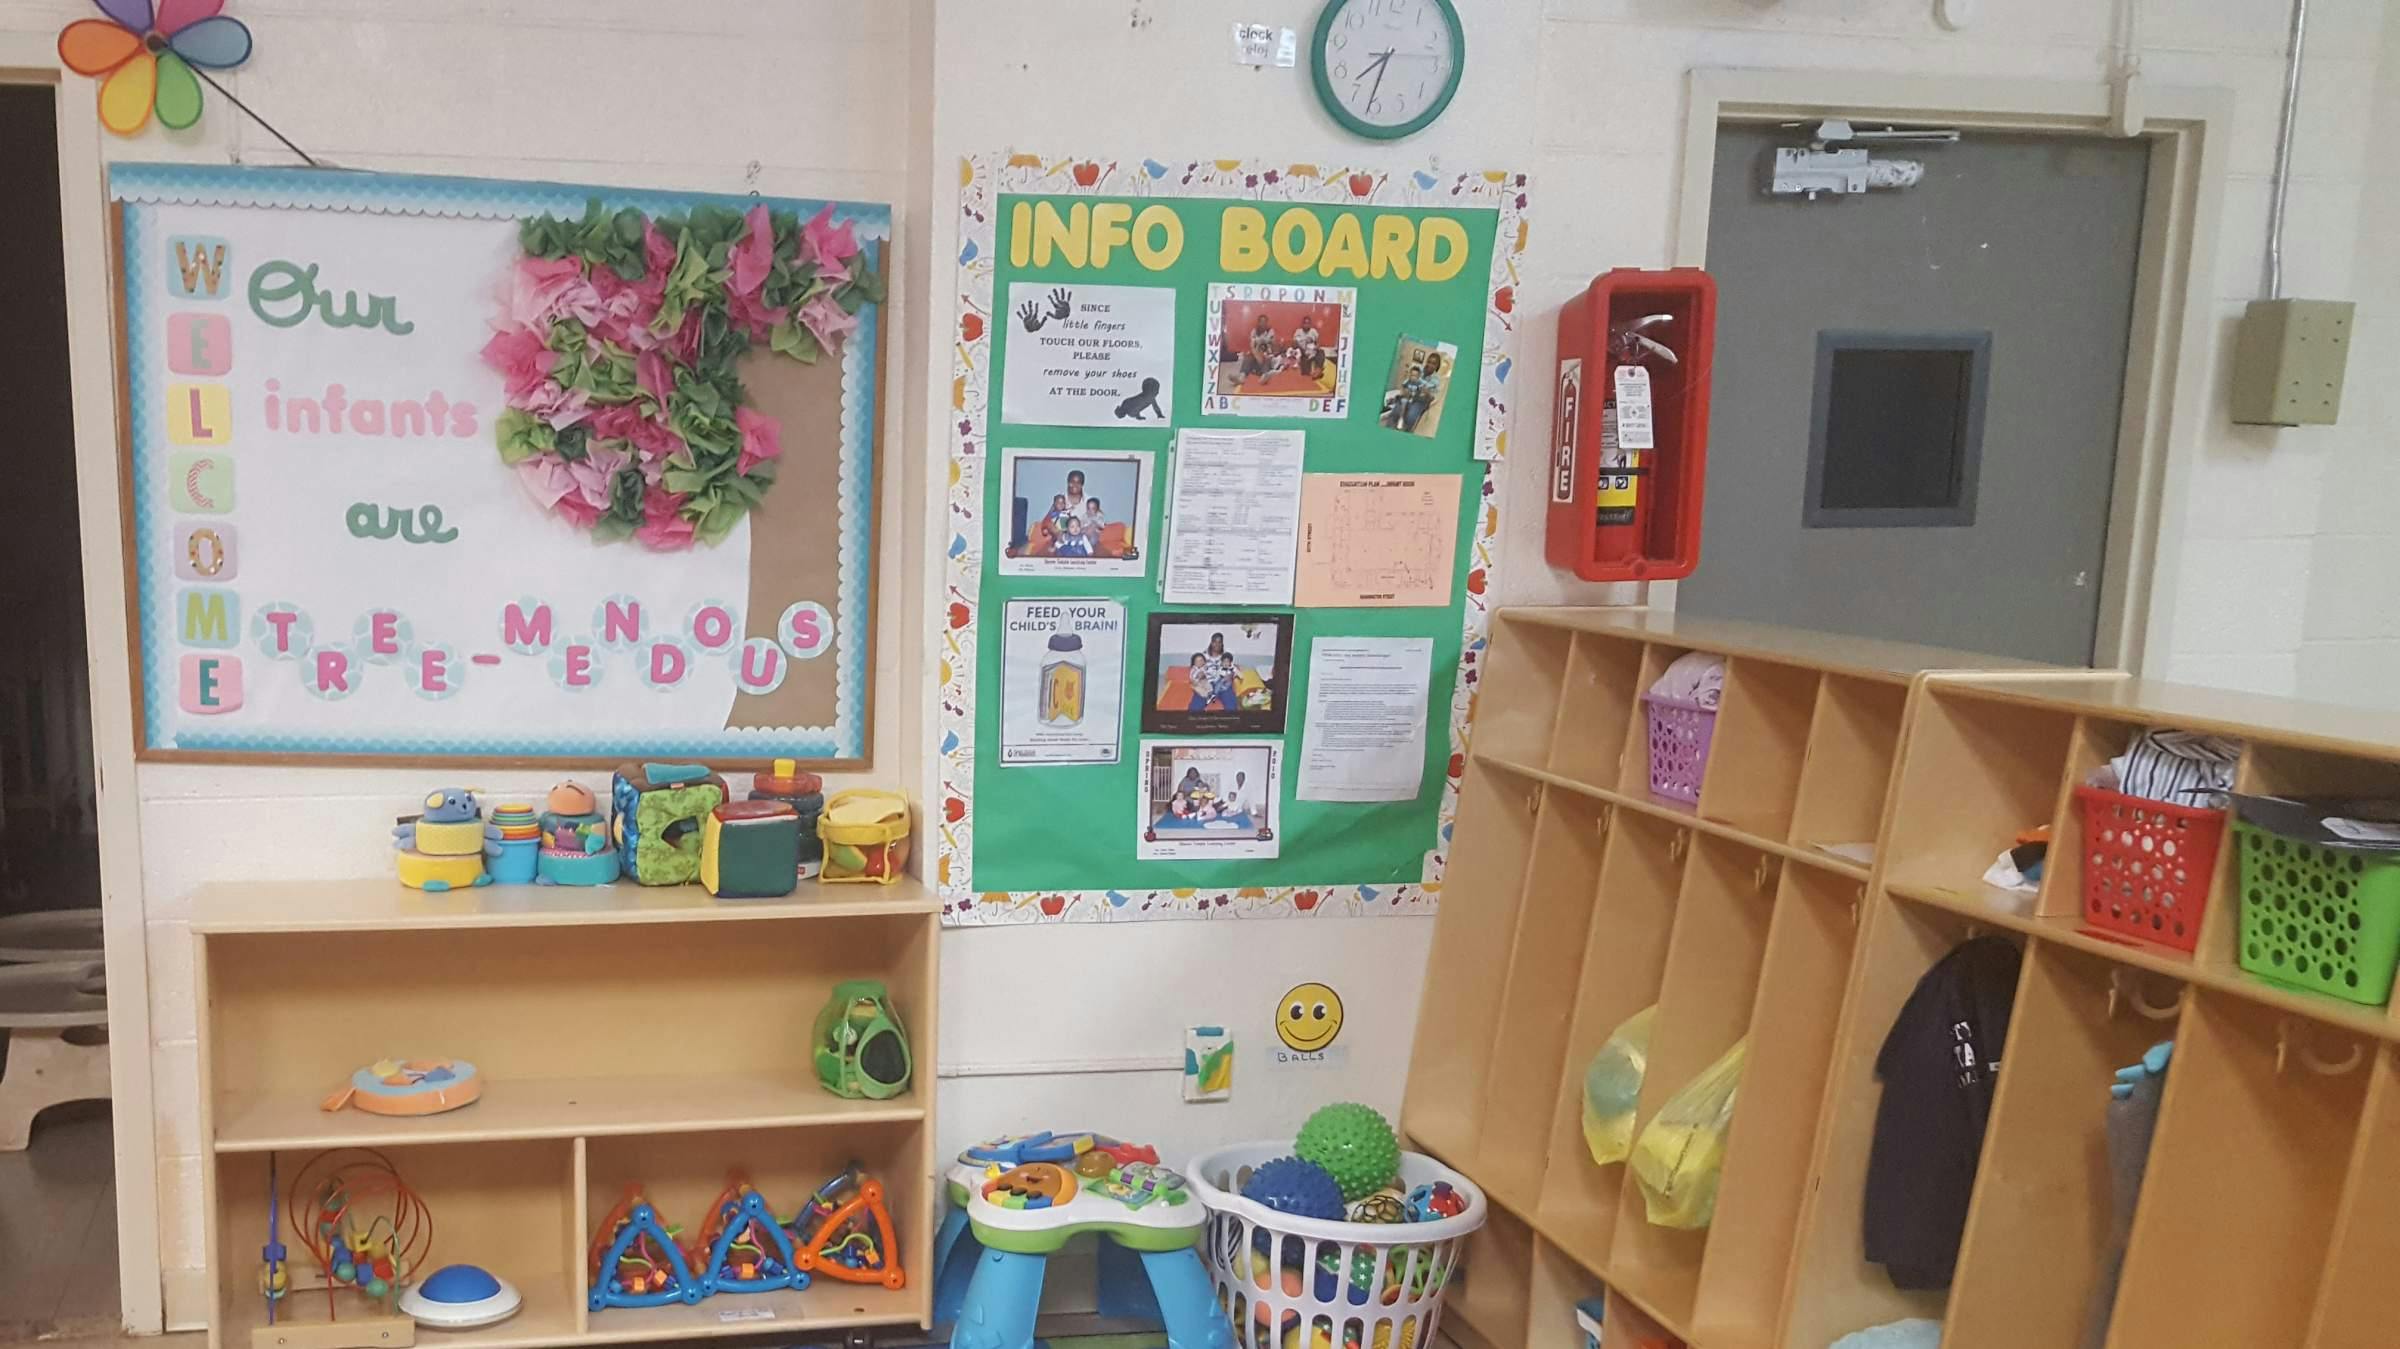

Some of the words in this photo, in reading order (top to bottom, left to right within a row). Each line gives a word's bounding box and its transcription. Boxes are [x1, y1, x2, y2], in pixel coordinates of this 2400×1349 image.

[1239, 27, 1273, 41] clock
[1010, 201, 1185, 271] INFO
[1220, 206, 1469, 281] BOARD
[248, 259, 414, 336] Our
[1080, 304, 1111, 313] SINCE
[1062, 319, 1089, 330] little
[1094, 320, 1126, 333] fingers
[1040, 337, 1075, 346] TOUCH
[1078, 338, 1100, 347] OUR
[1102, 339, 1144, 350] FLOORS,
[1073, 352, 1111, 361] PLEASE
[1043, 368, 1080, 377] remove
[1085, 369, 1107, 380] your
[1112, 368, 1137, 379] shoes
[1049, 387, 1063, 395] AT
[1066, 388, 1087, 396] THE
[1090, 388, 1121, 397] DOOR.
[263, 377, 478, 438] infants
[1560, 397, 1574, 492] FIRE
[346, 501, 458, 544] are
[1026, 606, 1061, 618] FEED
[1068, 607, 1106, 618] YOUR
[1009, 621, 1057, 632] CHILD'S
[1075, 620, 1118, 632] BRAIN!
[1277, 1051, 1325, 1063] BALLS
